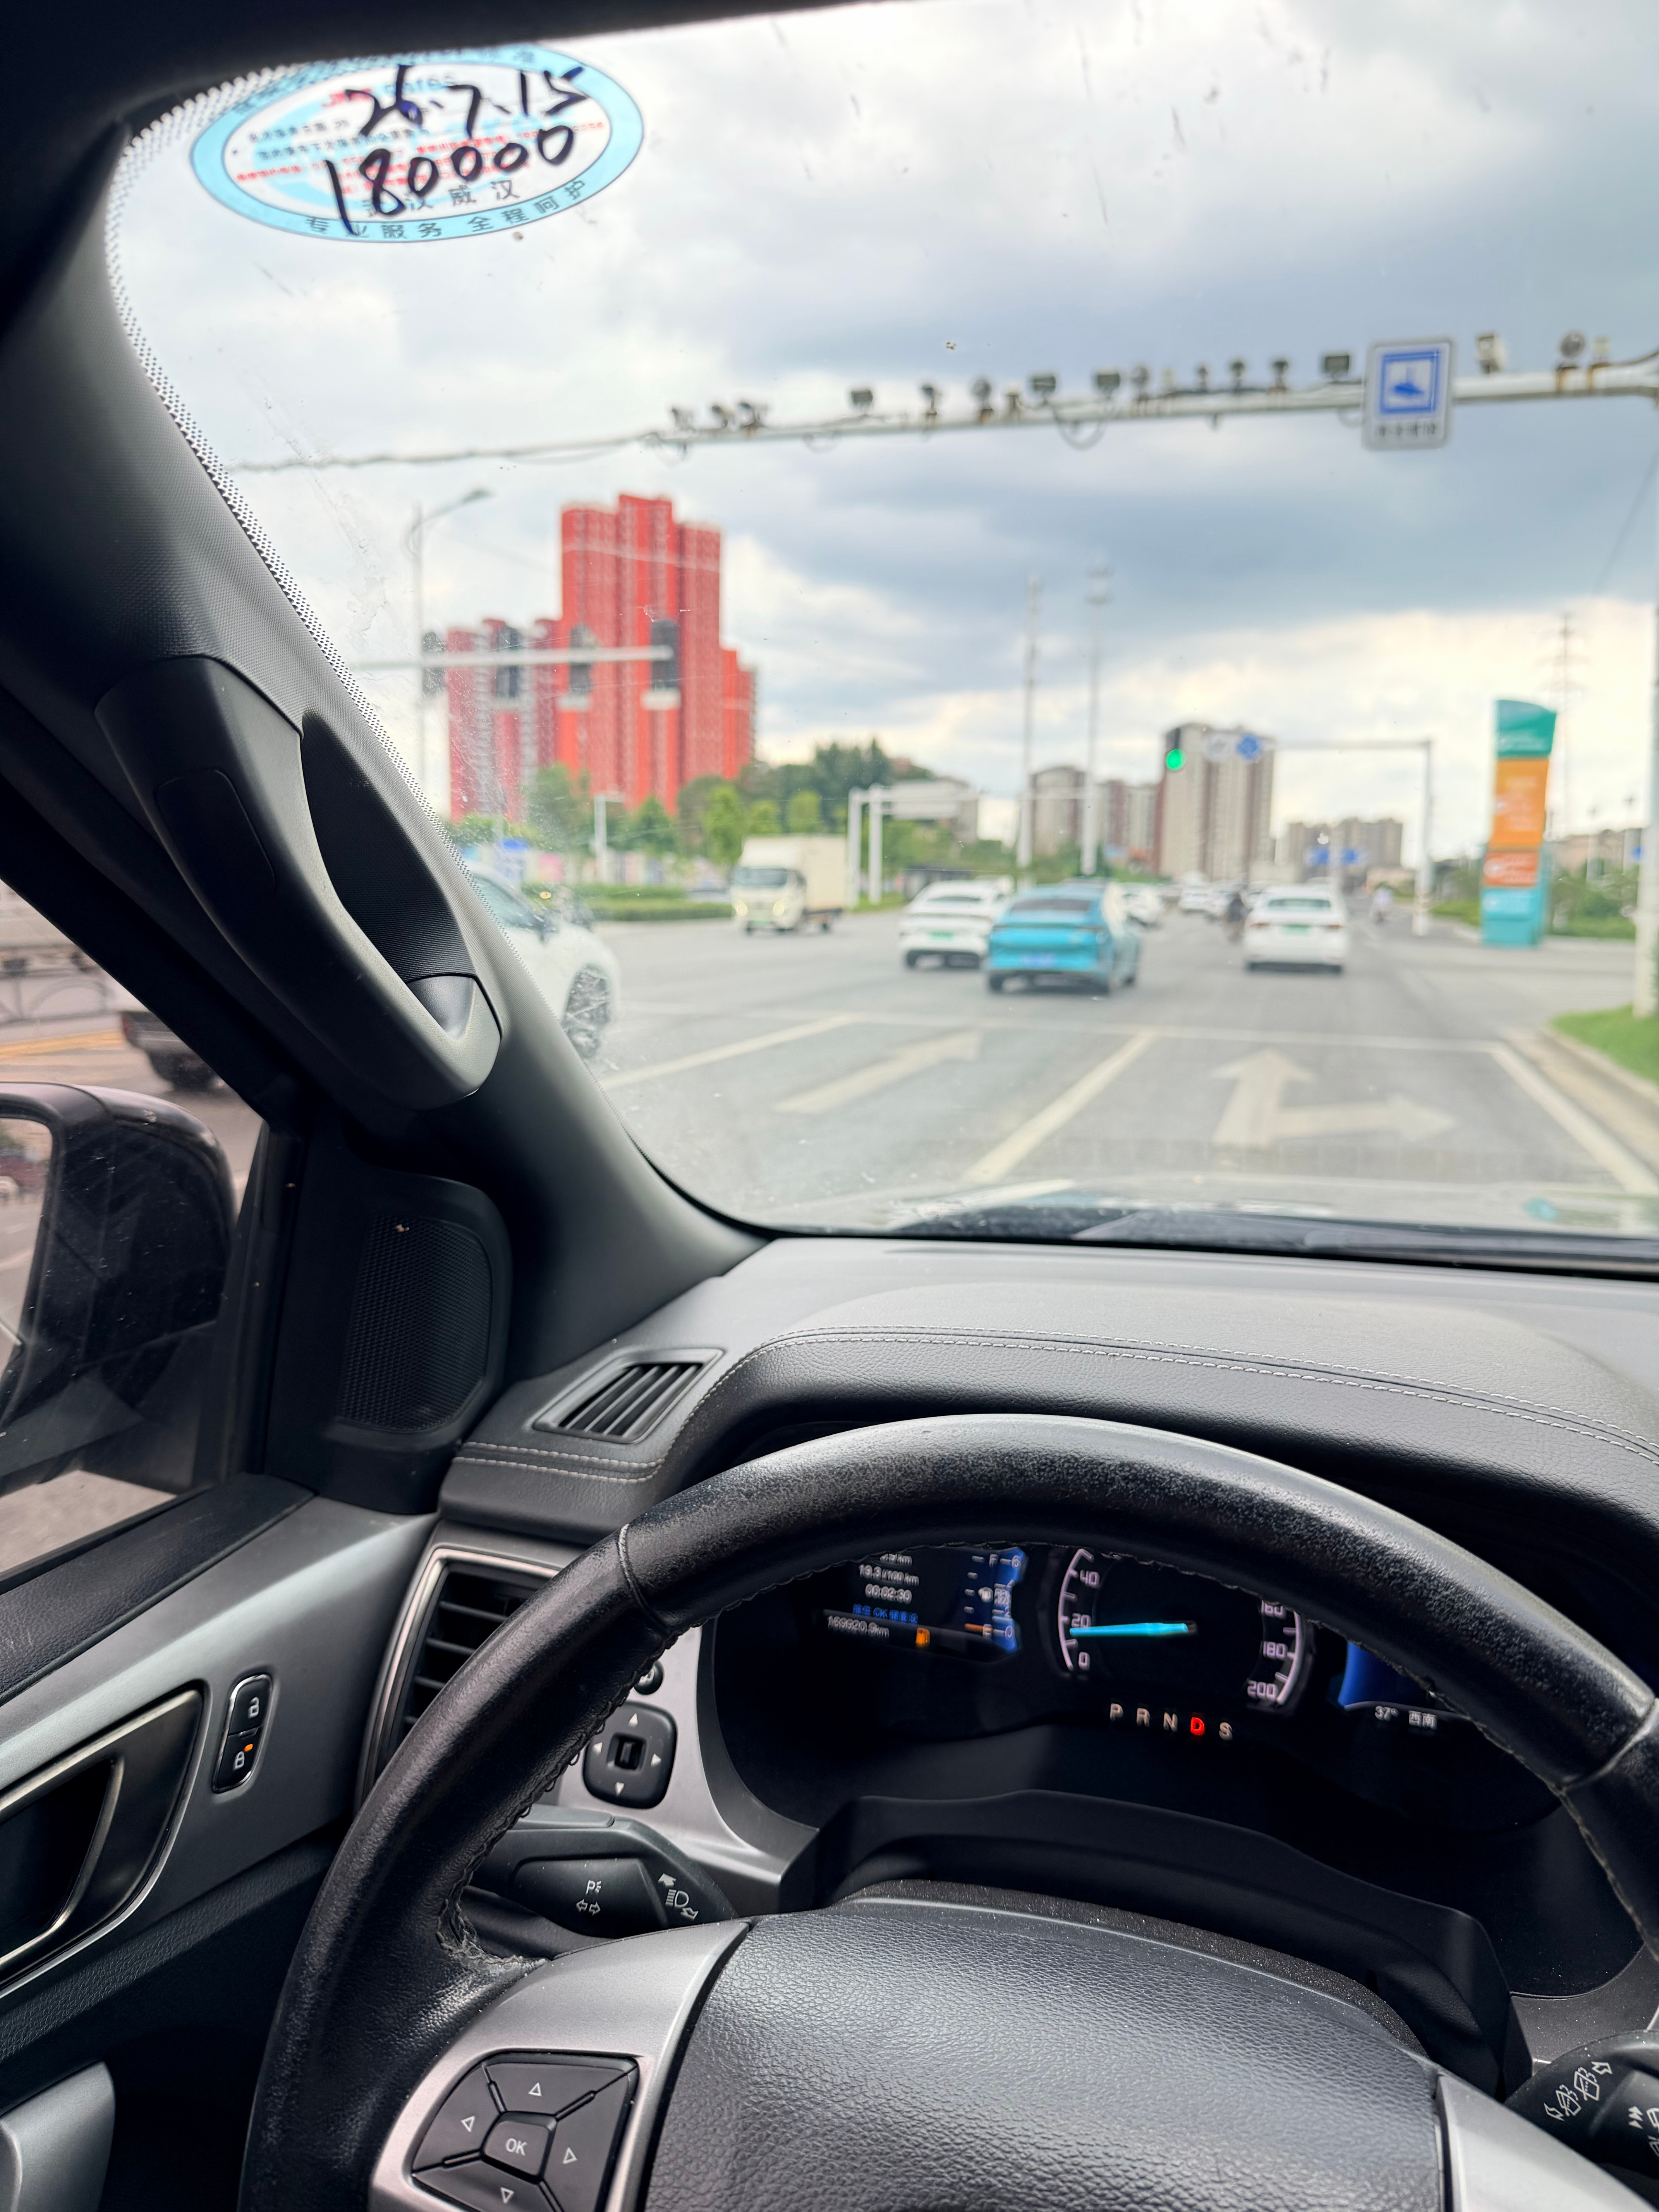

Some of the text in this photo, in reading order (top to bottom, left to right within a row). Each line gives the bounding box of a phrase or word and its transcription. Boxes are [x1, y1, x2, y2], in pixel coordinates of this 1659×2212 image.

[325, 125, 574, 235] 180000
[1080, 1570, 1099, 1588] 40
[865, 1583, 912, 1604] 00:02:30
[1071, 1613, 1091, 1628] 20
[1263, 1641, 1288, 1660] 180
[1078, 1651, 1091, 1671] 0
[1247, 1680, 1278, 1701] 200
[1109, 1703, 1233, 1741] P R N D S
[505, 2138, 527, 2157] OK
